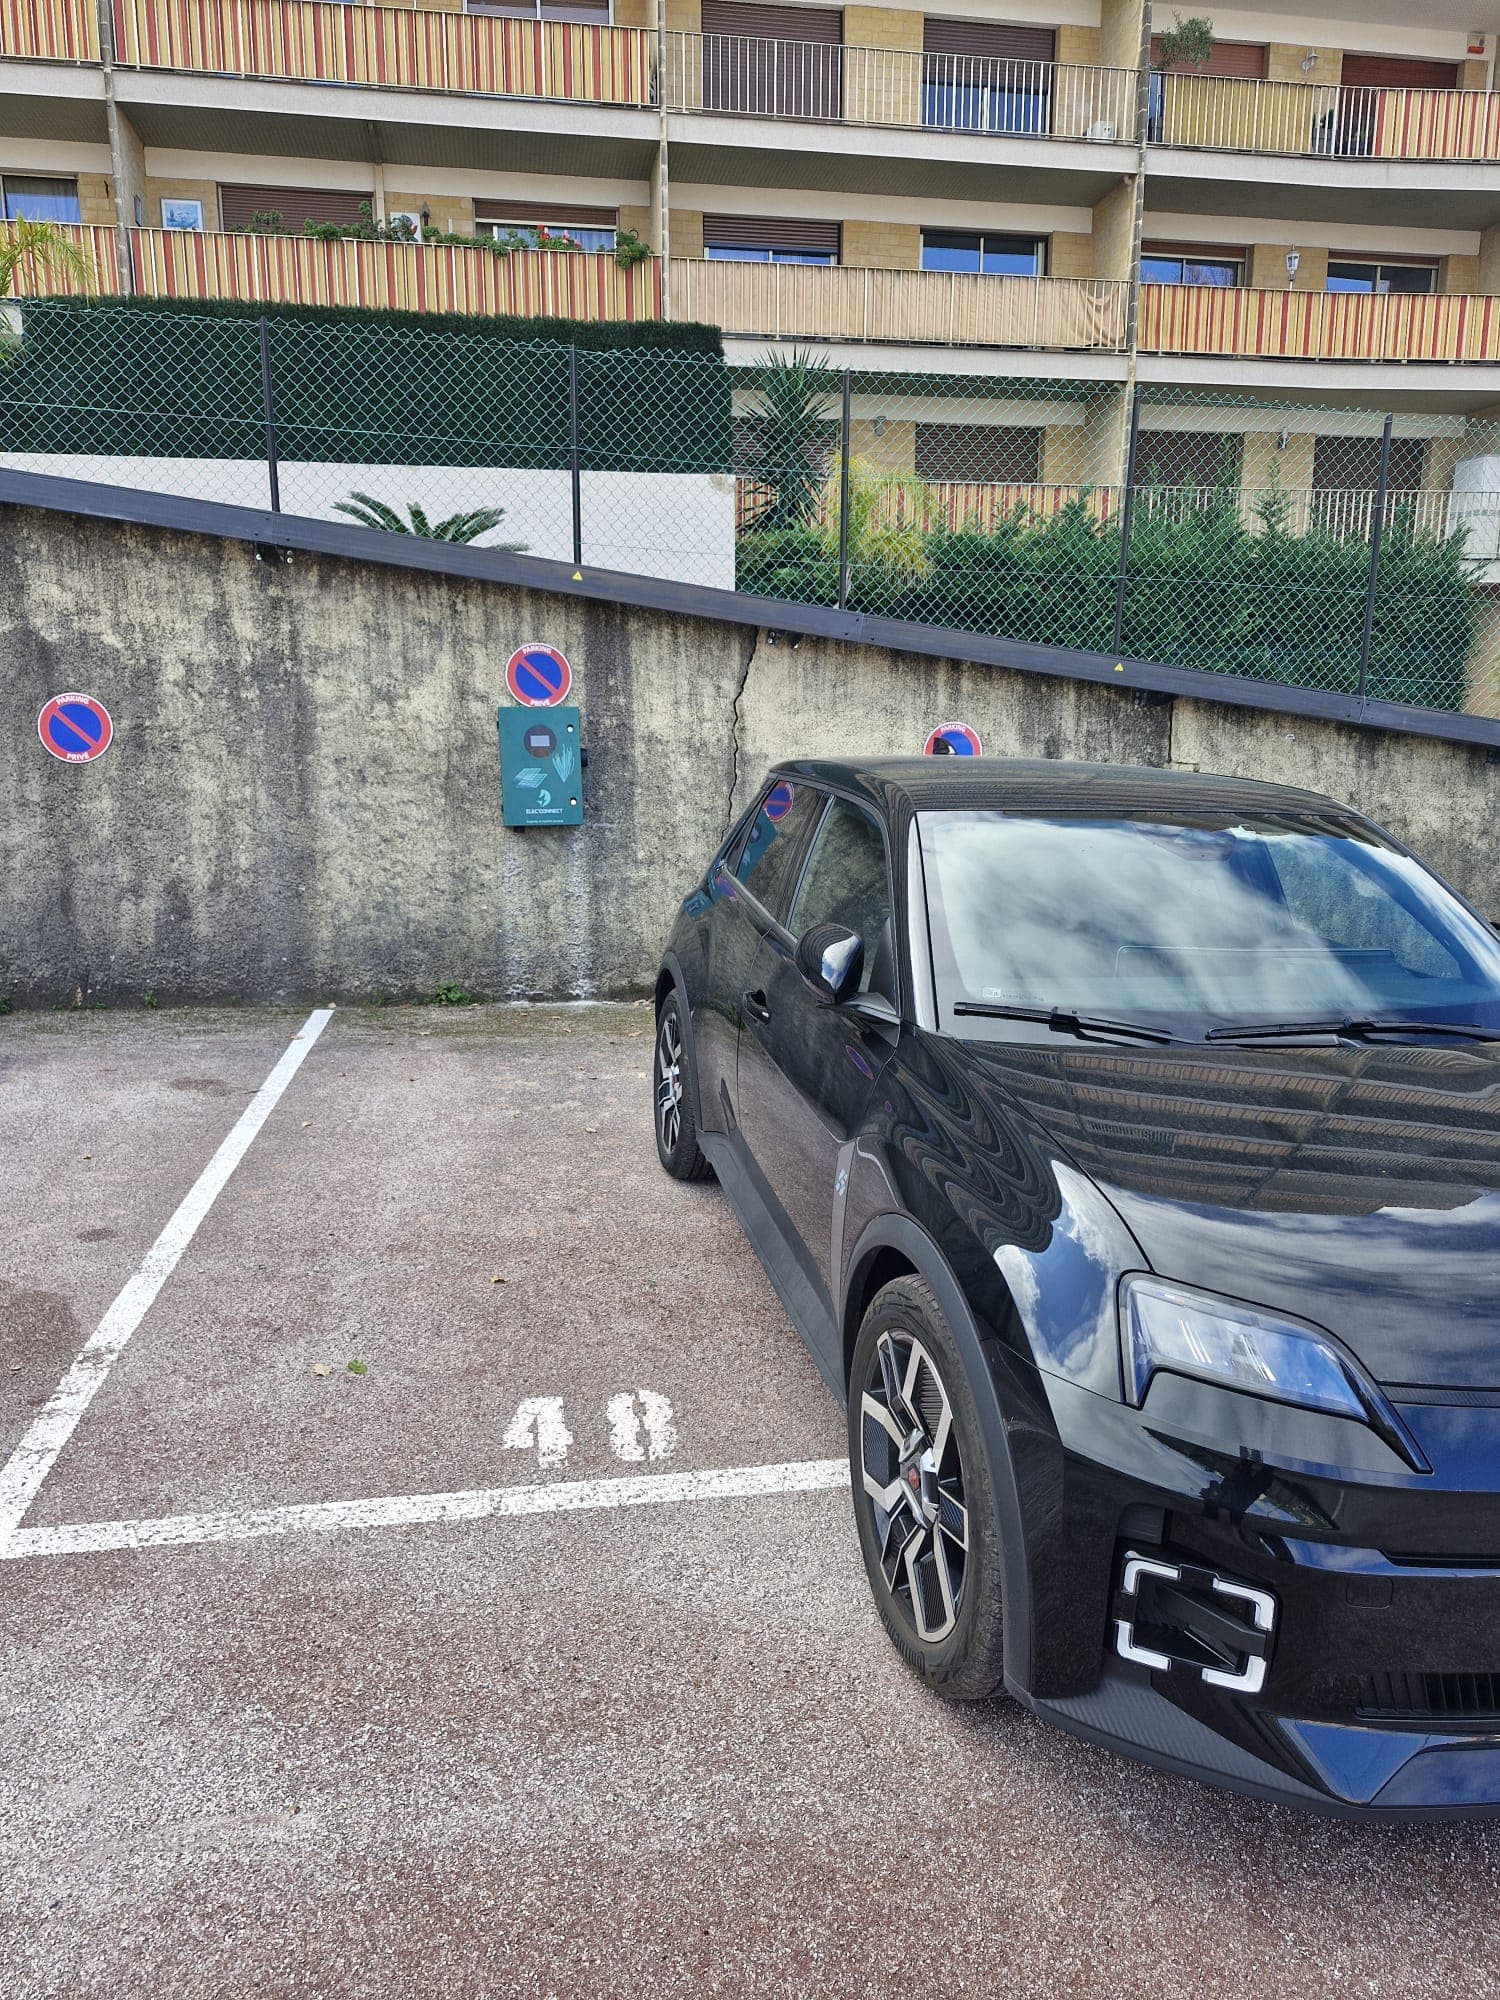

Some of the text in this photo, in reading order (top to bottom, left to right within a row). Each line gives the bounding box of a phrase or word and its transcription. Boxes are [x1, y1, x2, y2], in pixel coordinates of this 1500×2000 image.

[522, 645, 552, 655] PARKING
[56, 695, 90, 705] PARKING
[941, 724, 967, 734] PARKING
[502, 1390, 677, 1469] 48
